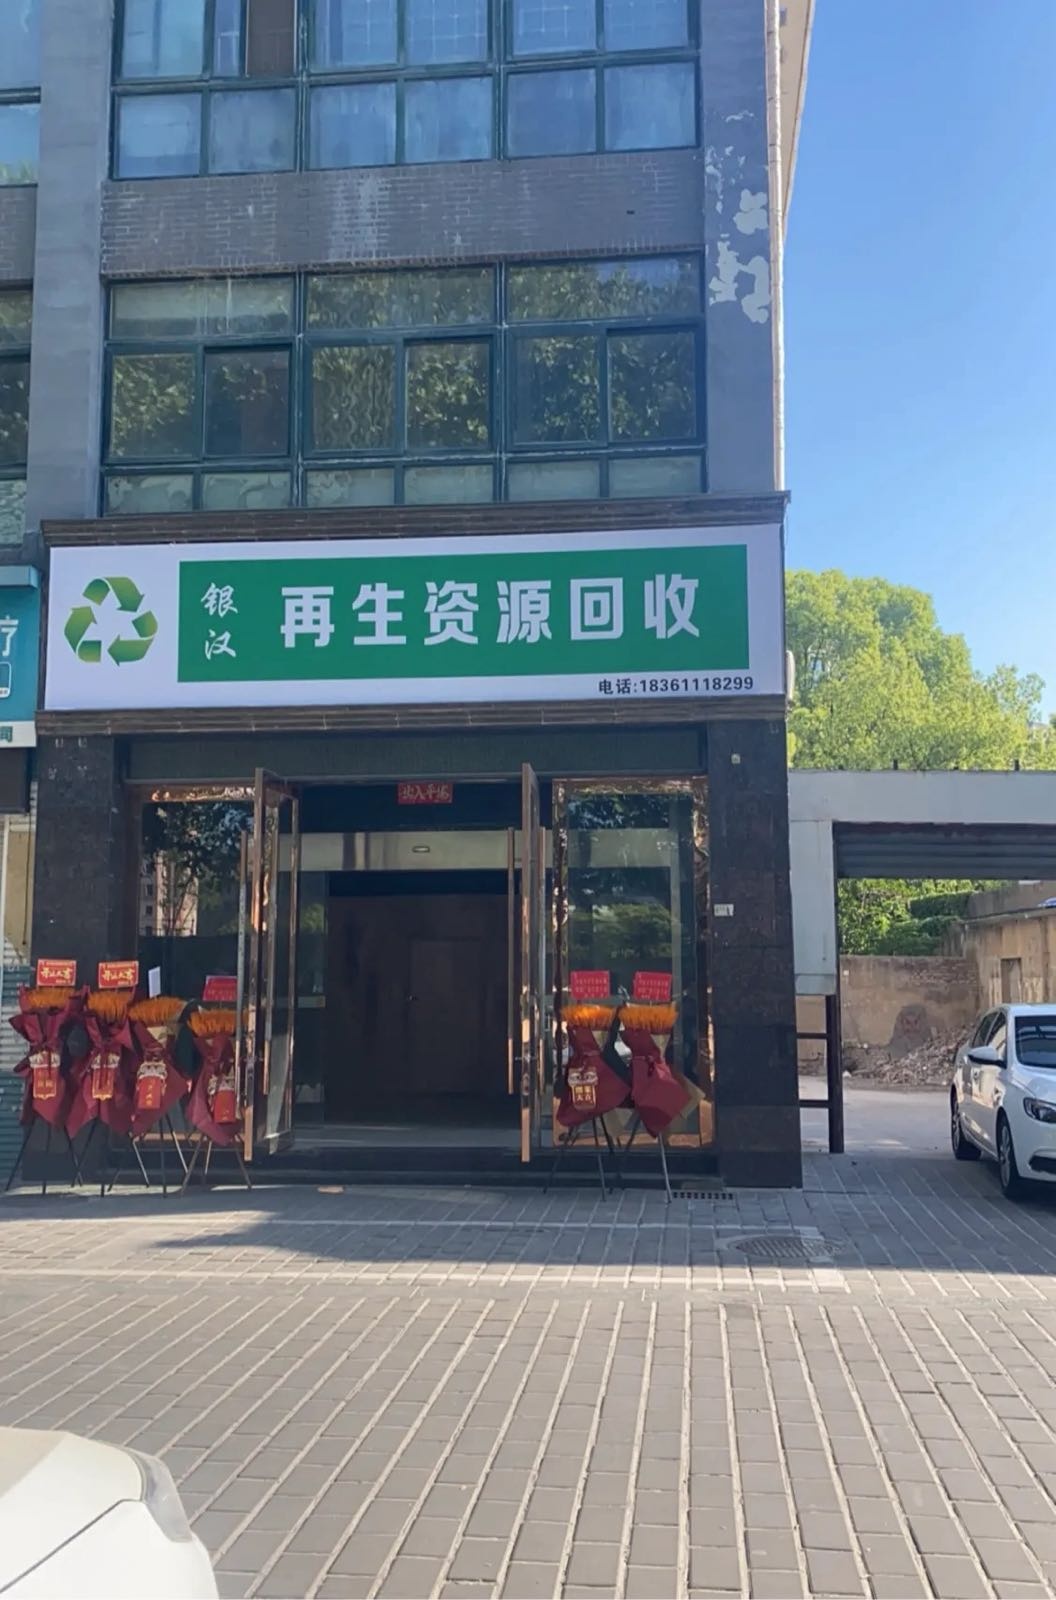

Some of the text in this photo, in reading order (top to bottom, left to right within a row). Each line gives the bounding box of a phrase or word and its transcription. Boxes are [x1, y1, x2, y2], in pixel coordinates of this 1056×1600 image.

[200, 582, 239, 660] 银汉
[280, 573, 700, 648] 再生资源回收
[598, 676, 754, 695] 电话:18361118299
